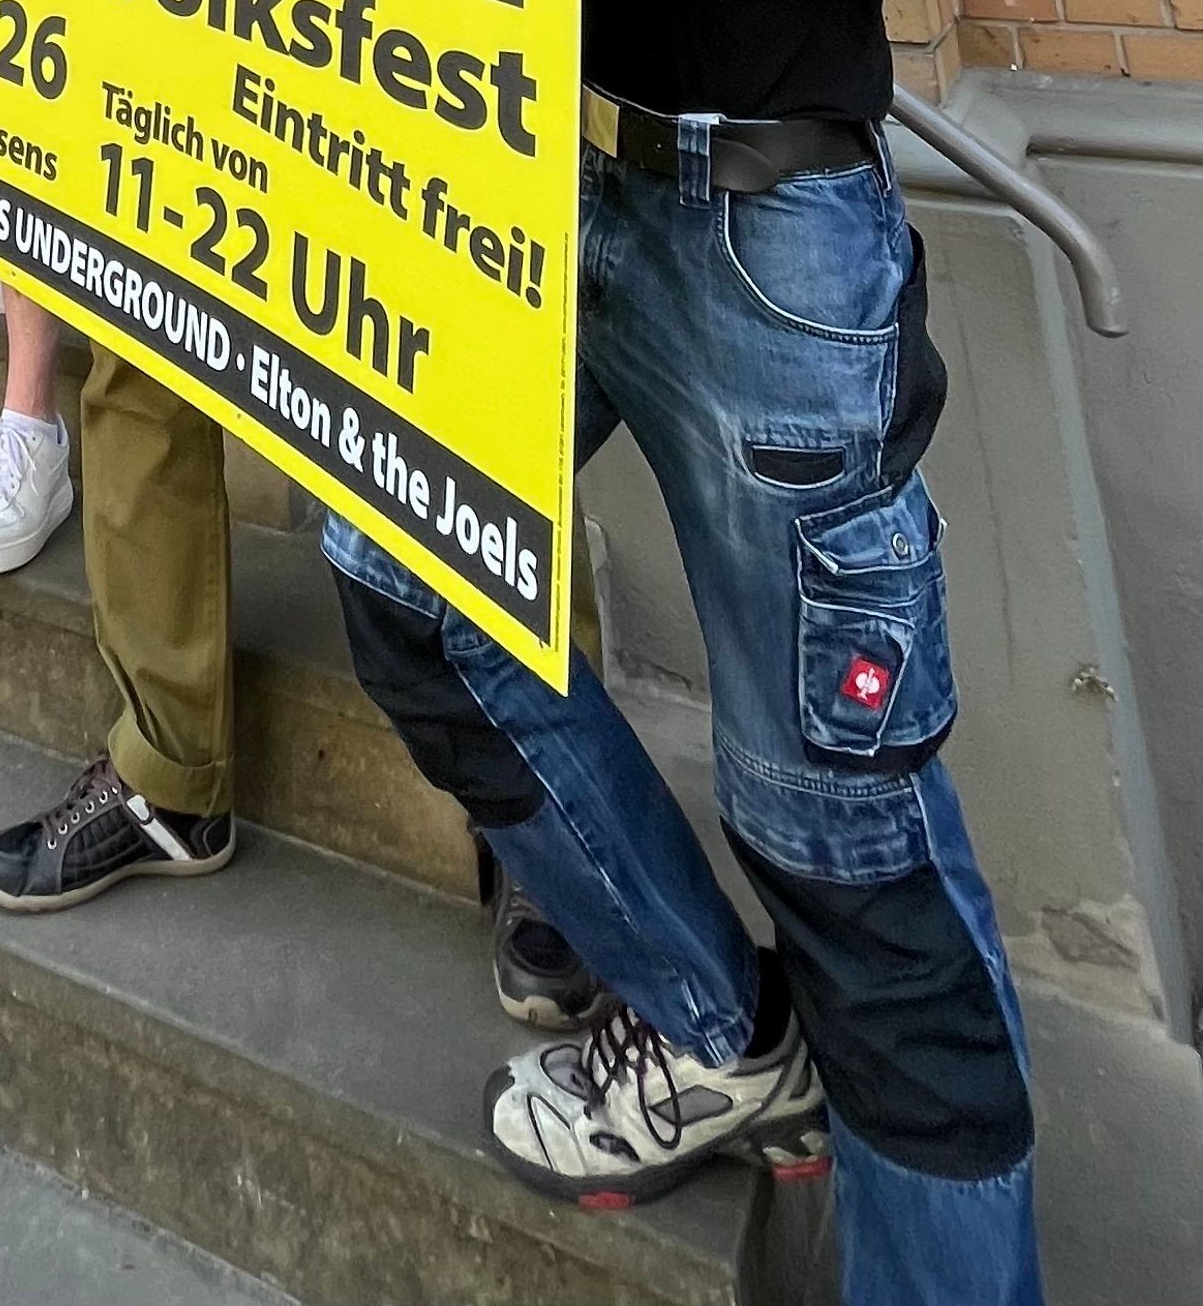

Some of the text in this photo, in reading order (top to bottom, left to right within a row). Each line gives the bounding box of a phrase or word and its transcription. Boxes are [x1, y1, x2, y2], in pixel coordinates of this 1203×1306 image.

[101, 80, 269, 194] Täglich von
[231, 62, 547, 310] Eintritt frei!
[100, 141, 431, 396] 11-22 Uhr
[14, 206, 232, 372] UNDERGROUND
[250, 343, 332, 451] Elton
[337, 406, 365, 474] &
[371, 432, 431, 519] the
[435, 474, 539, 602] Joels
